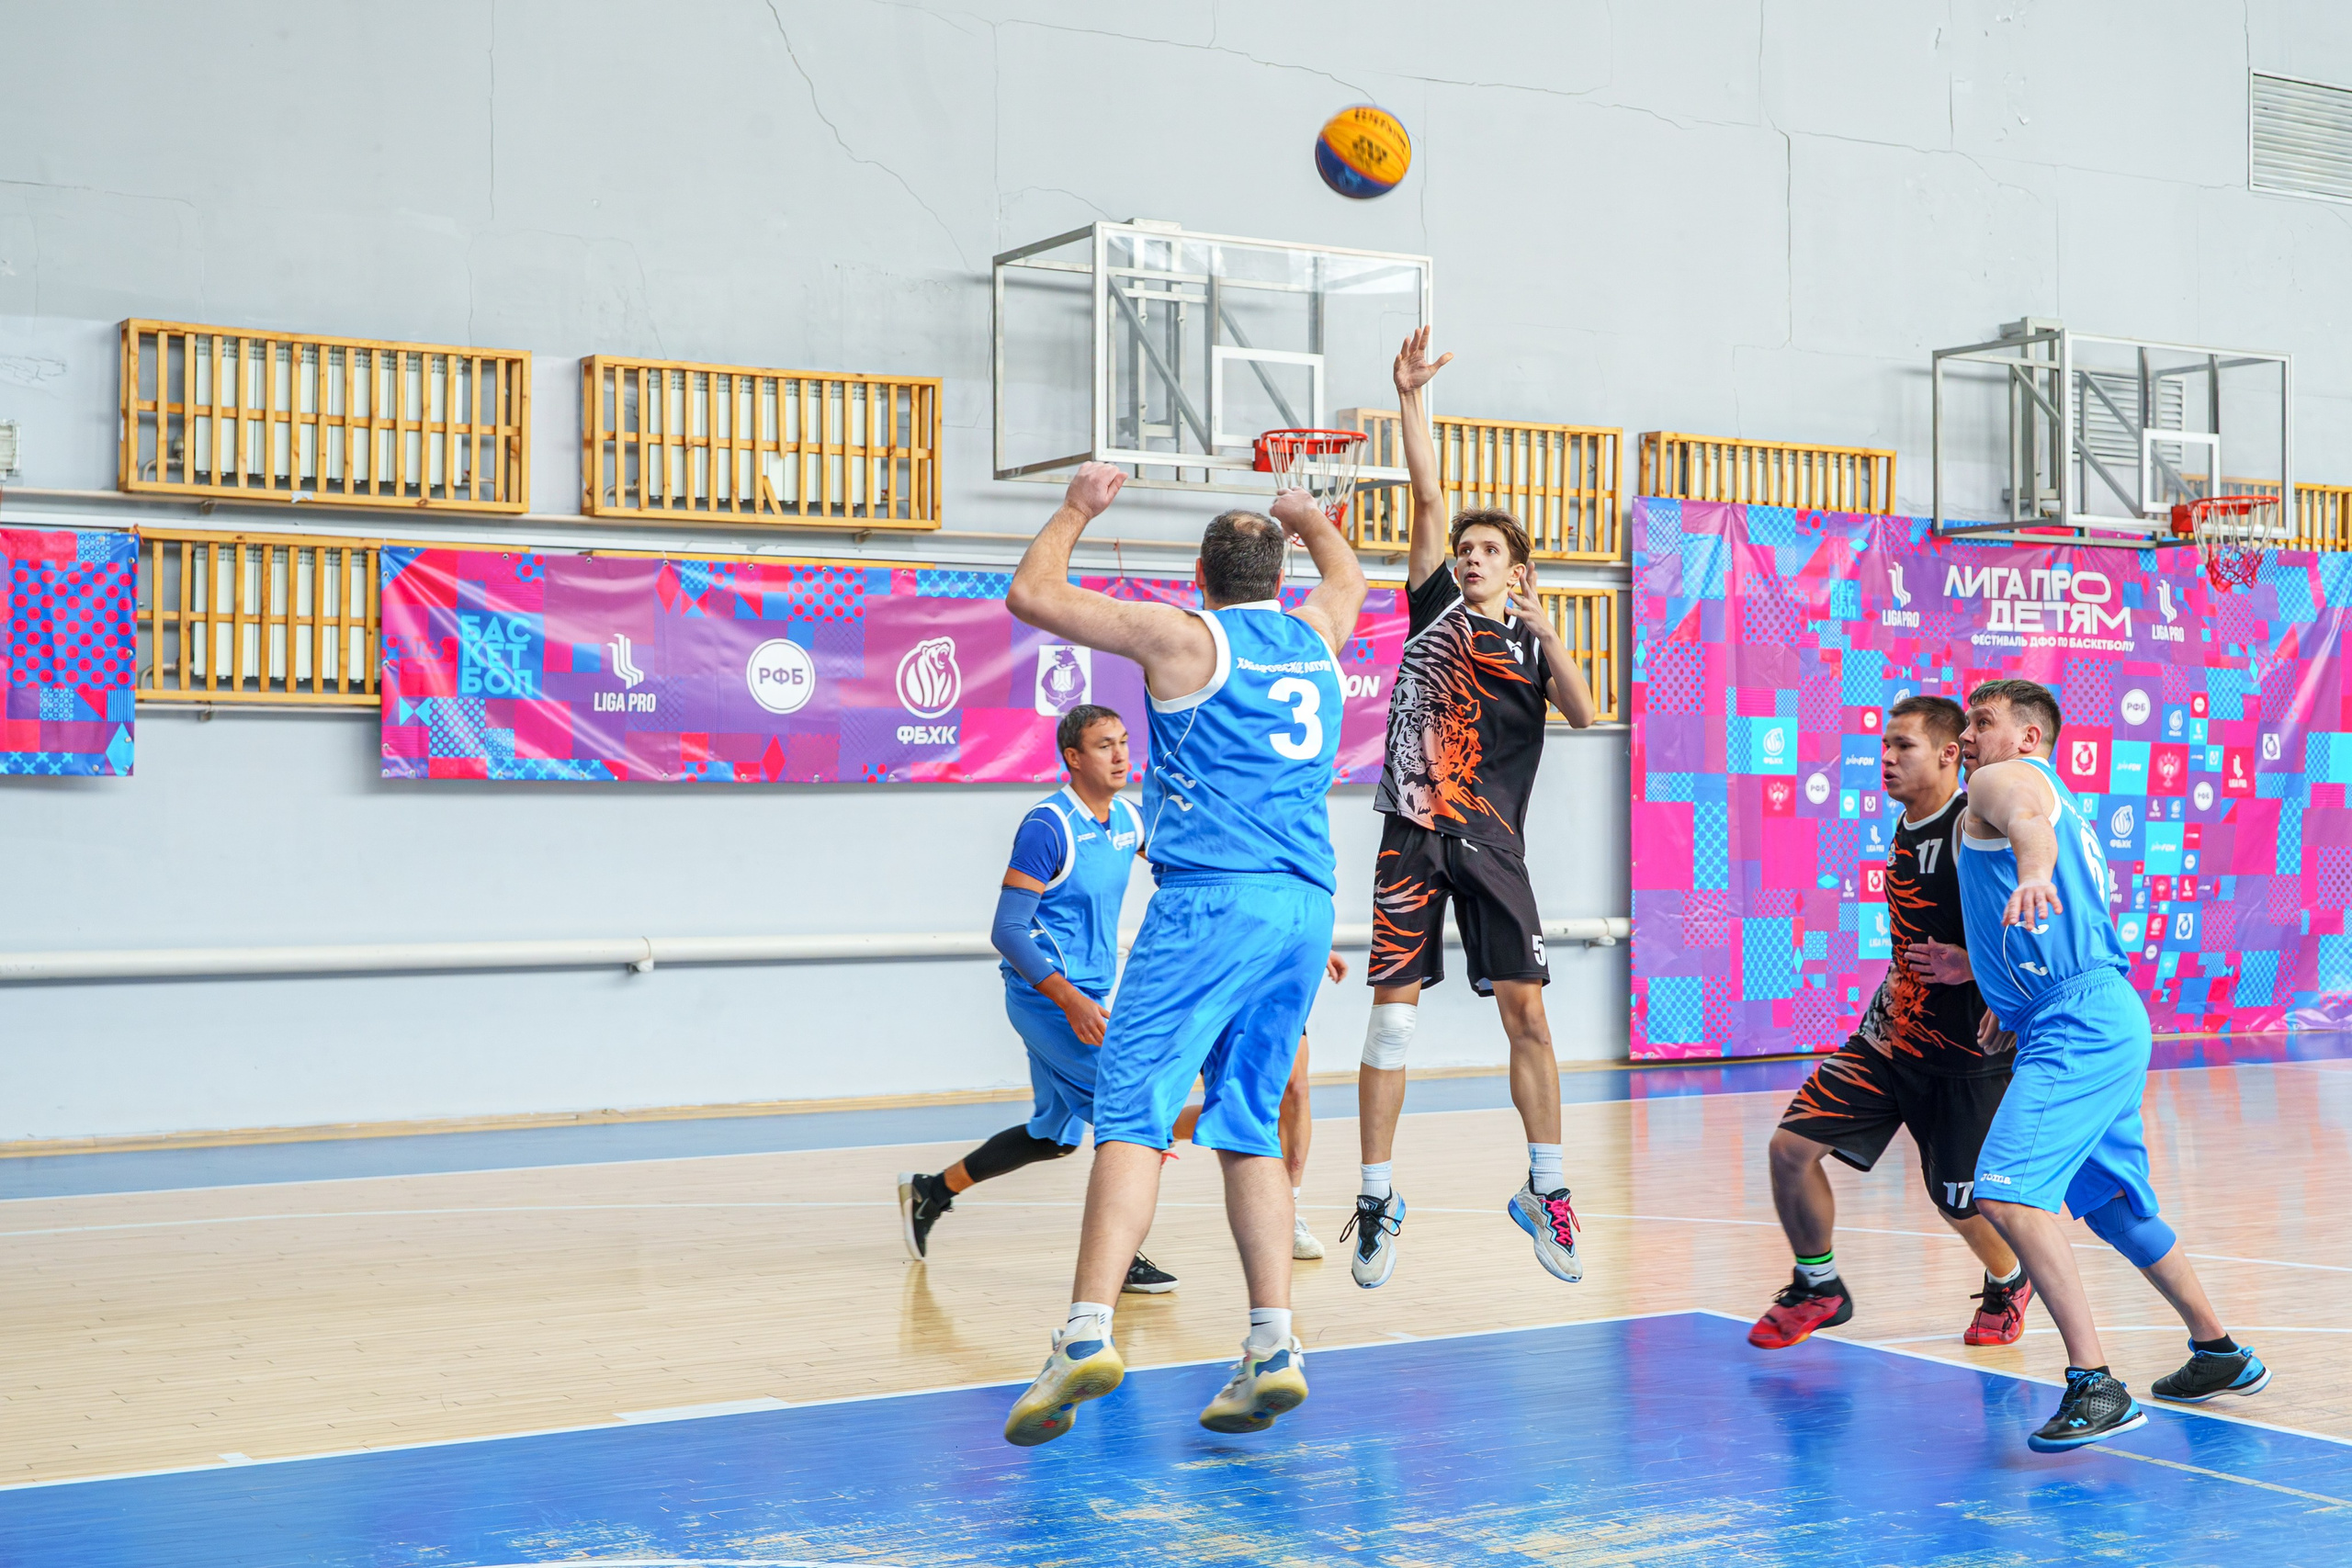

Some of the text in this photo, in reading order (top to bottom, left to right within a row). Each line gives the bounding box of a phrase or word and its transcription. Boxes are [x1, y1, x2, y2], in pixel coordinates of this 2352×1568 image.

[1943, 564, 2112, 604] ЛИГА ПРО
[461, 615, 533, 643] БАС
[1882, 609, 1920, 628] LIGA PRO
[1986, 599, 2132, 637] ДЕТЯМ
[1971, 633, 2029, 648] ФЕСТИВАЛЬ
[2030, 636, 2057, 649] ДФО
[2069, 637, 2135, 652] БАСКЕТБОЛУ
[2152, 624, 2185, 643] LIGA PRO
[462, 642, 528, 670] КЕТ
[461, 667, 533, 696] БОЛ
[759, 667, 804, 685] РФБ
[1345, 673, 1381, 699] ON
[594, 692, 657, 713] LIGA PRO
[2126, 703, 2146, 712] РФБ
[1267, 676, 1324, 761] 3
[896, 725, 957, 745] ФБХК
[1916, 838, 1944, 874] 17
[1532, 933, 1547, 967] 5
[1980, 1173, 2012, 1185] Joma
[1942, 1180, 1974, 1210] 17
